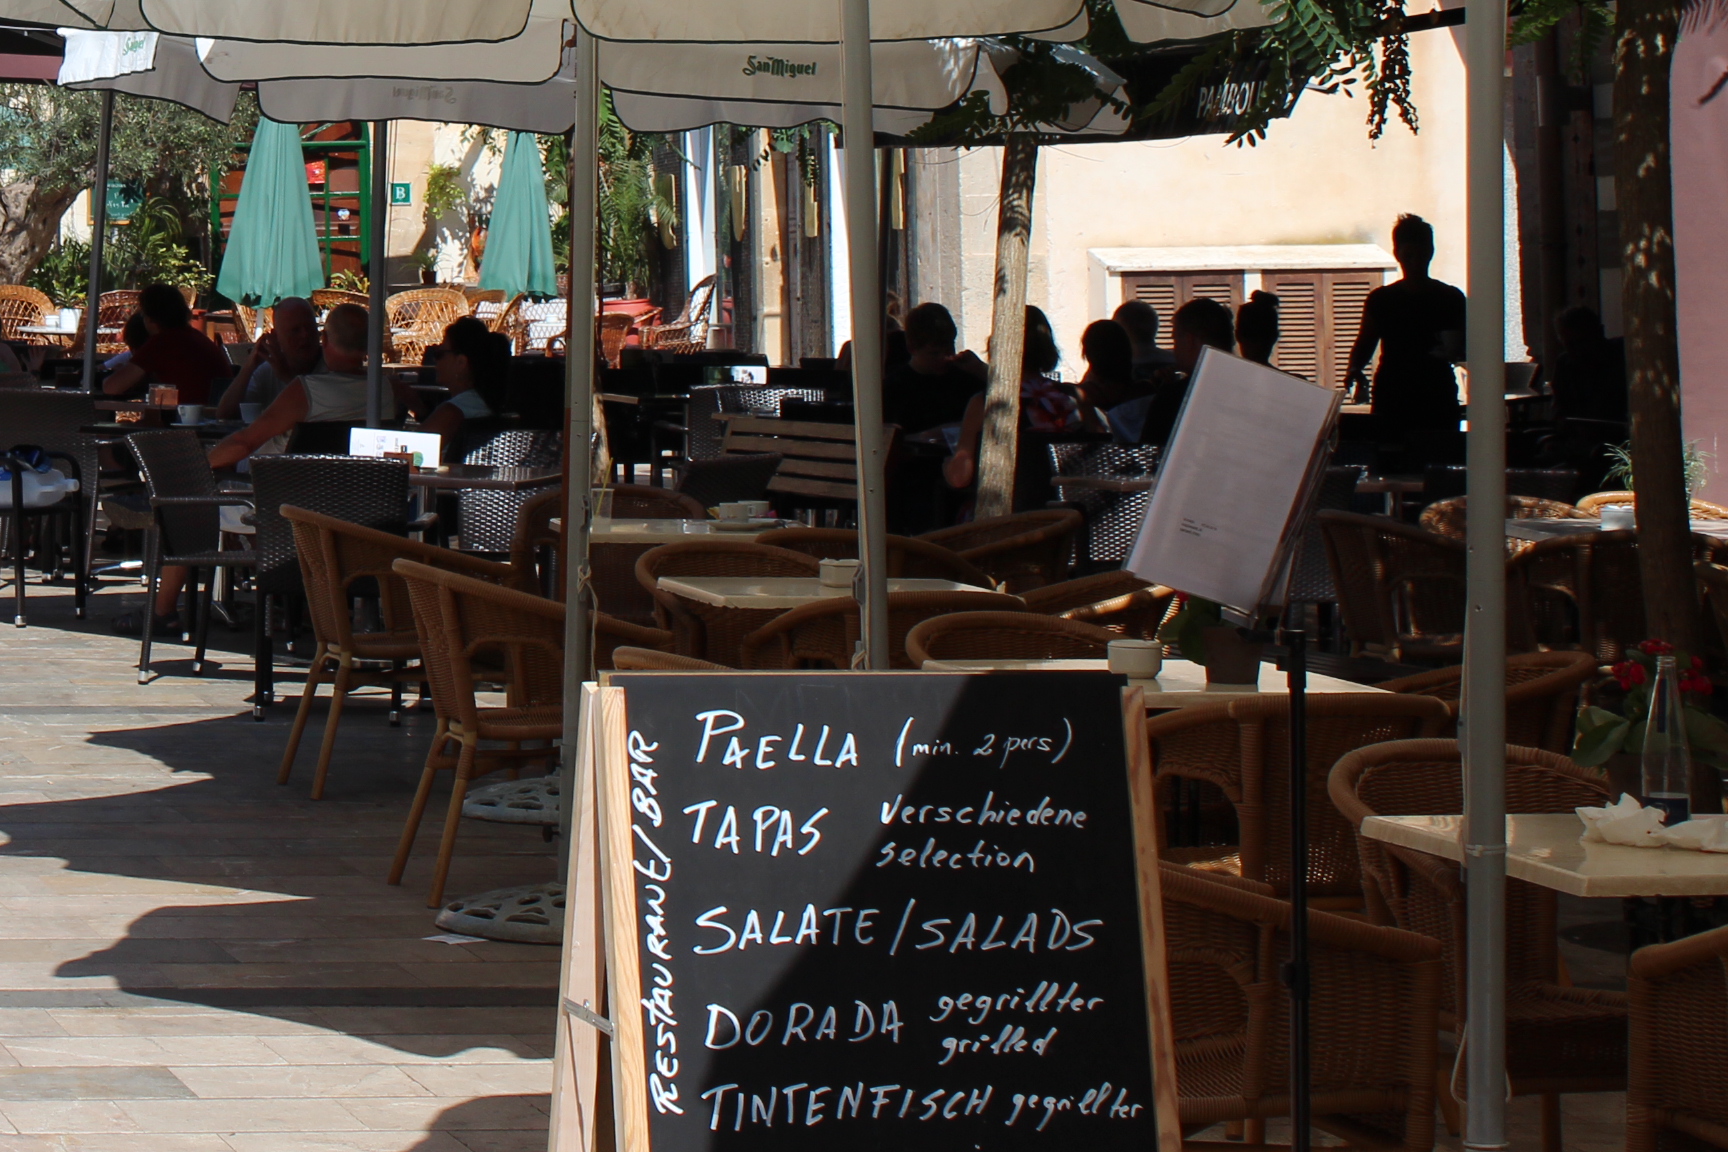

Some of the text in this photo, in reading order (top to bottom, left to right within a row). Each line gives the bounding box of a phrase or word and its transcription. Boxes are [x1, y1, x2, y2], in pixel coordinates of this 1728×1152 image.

[395, 186, 406, 200] B
[695, 709, 858, 769] PAELLA
[973, 733, 995, 755] 2
[683, 799, 829, 856] TAPAS
[876, 837, 1035, 873] selection
[704, 981, 1104, 1049] DORADA gegrillter
[937, 1024, 1058, 1066] grilled
[701, 1082, 1144, 1132] TINTENFISCH gegrillter
